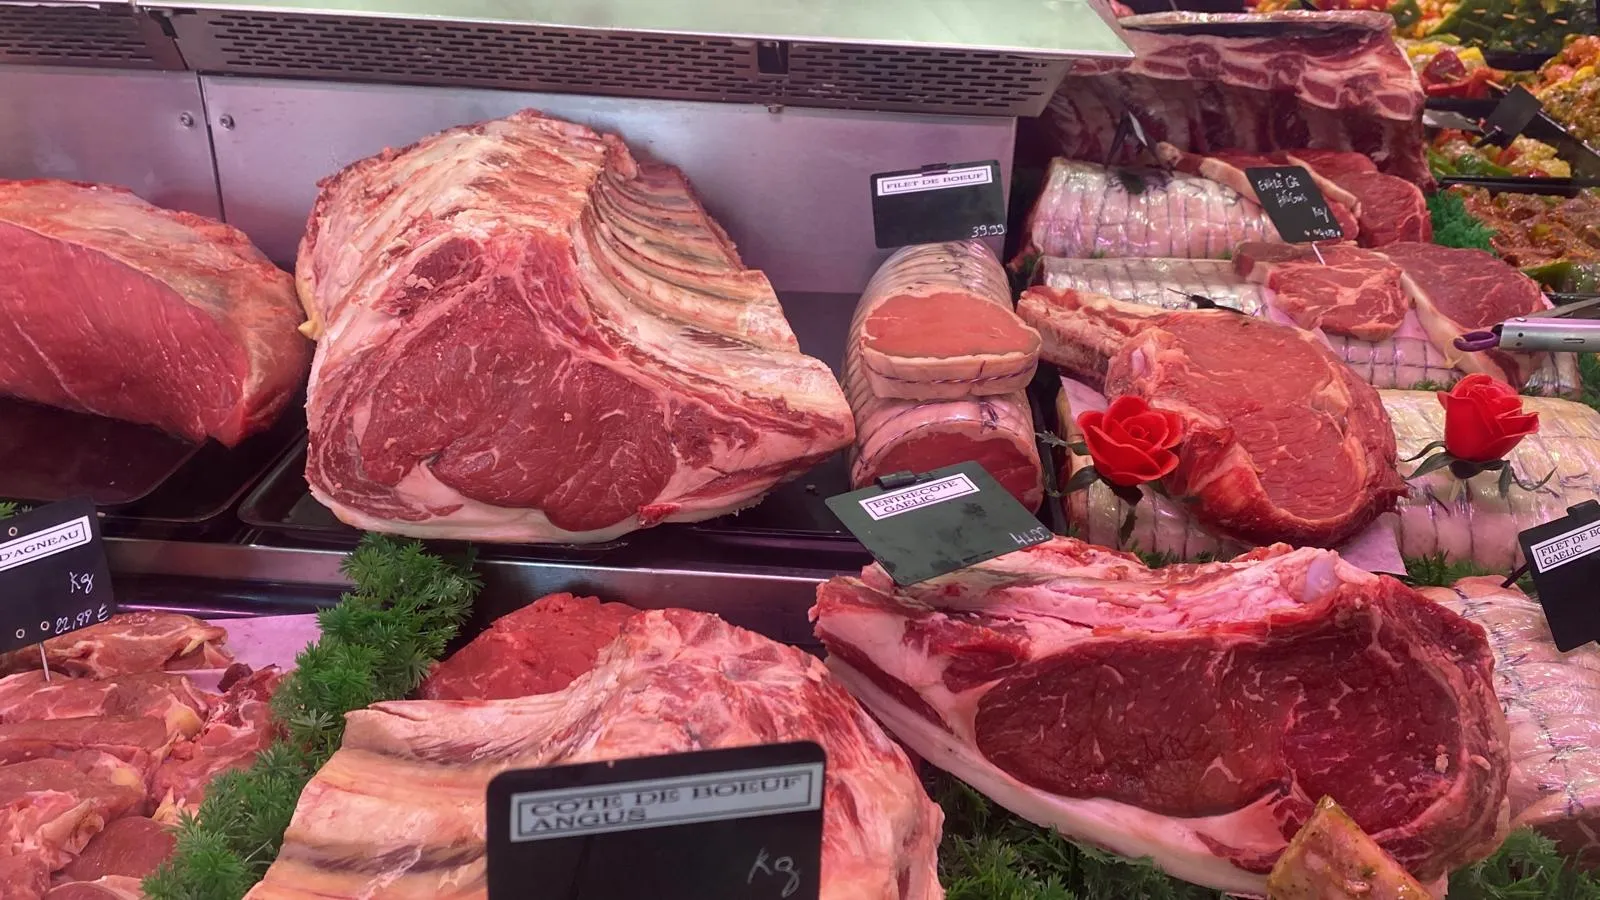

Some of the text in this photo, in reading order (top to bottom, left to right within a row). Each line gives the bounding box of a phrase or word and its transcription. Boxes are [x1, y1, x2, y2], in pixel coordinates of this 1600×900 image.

[886, 172, 984, 190] FILET DE BOEUF
[873, 480, 958, 509] ENTRECOTE
[883, 494, 936, 514] GAELIC
[0, 530, 79, 561] D'AGNEAU
[1541, 540, 1570, 557] FILET
[1572, 532, 1588, 545] DE
[1543, 544, 1583, 565] GAELIC
[69, 571, 94, 594] Kg
[530, 775, 801, 818] COTE DE BOEUF
[530, 807, 647, 834] ANGUS
[747, 847, 801, 898] Kg
